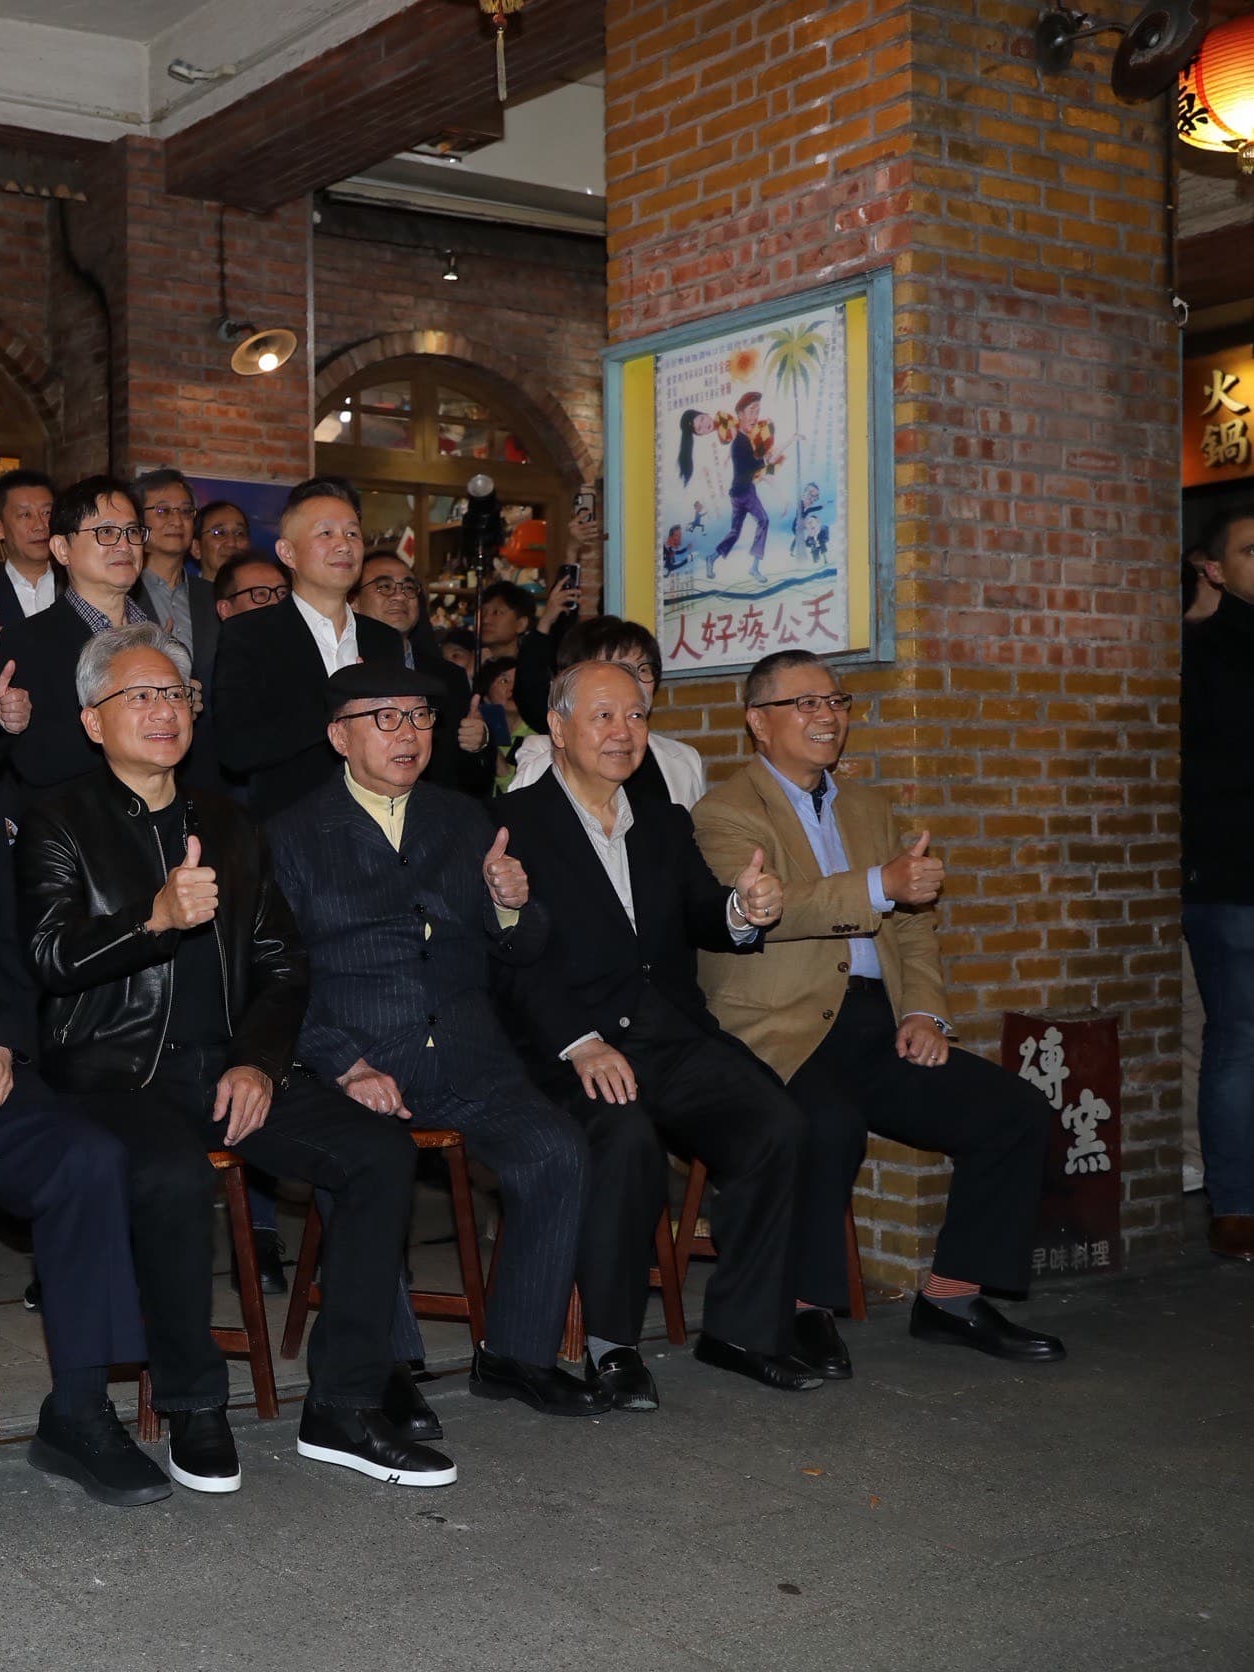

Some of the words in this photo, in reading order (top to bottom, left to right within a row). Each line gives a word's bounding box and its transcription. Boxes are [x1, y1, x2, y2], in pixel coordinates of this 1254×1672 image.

[1200, 368, 1248, 468] 火鍋
[668, 589, 839, 660] 天公疼好人
